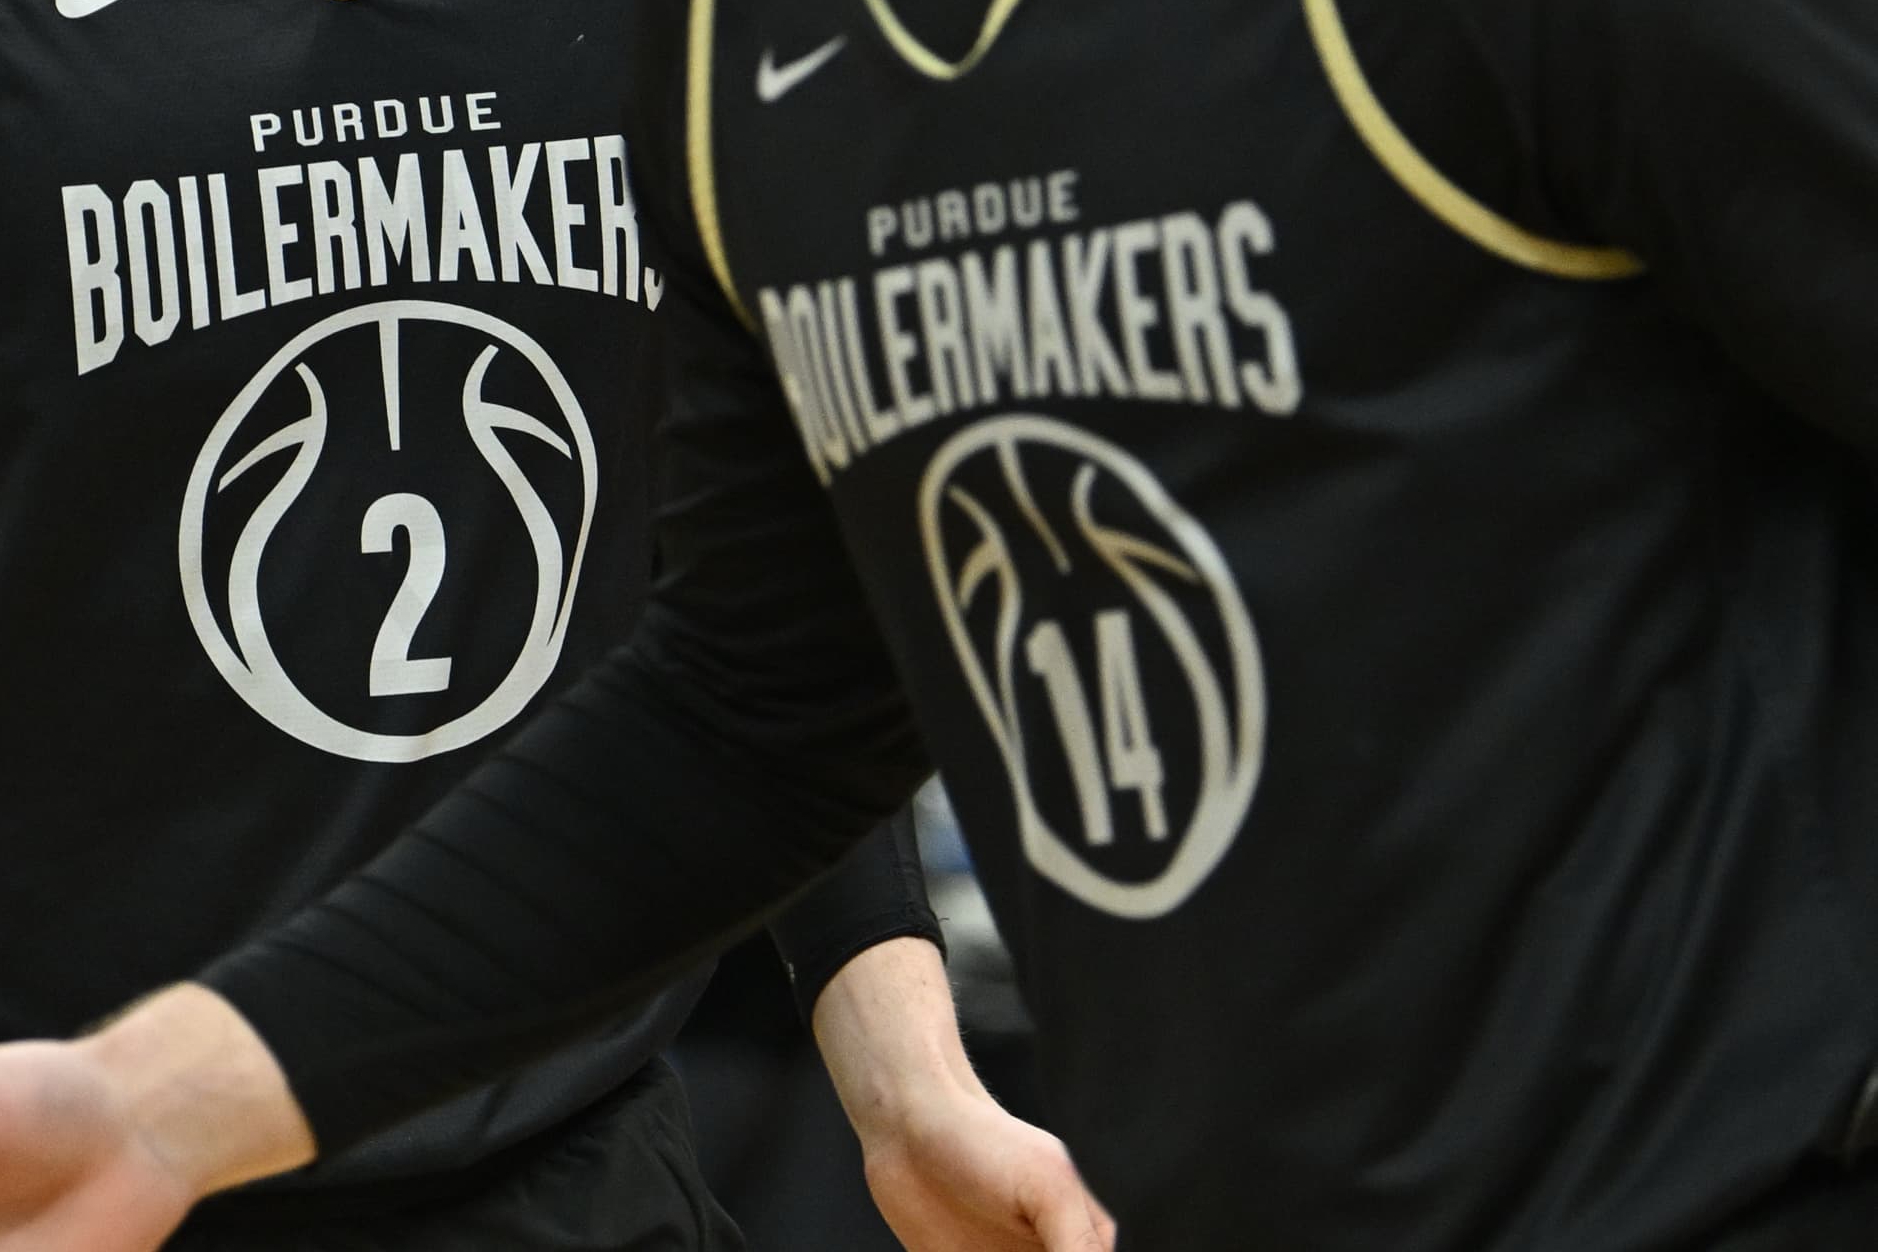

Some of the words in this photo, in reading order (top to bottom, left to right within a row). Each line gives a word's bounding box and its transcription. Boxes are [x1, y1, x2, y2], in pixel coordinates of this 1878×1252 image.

[250, 93, 502, 152] PURDUE
[868, 170, 1079, 255] PURDUE
[61, 134, 665, 376] BOILERMAKER
[361, 493, 453, 697] 2
[1026, 611, 1167, 845] 14
